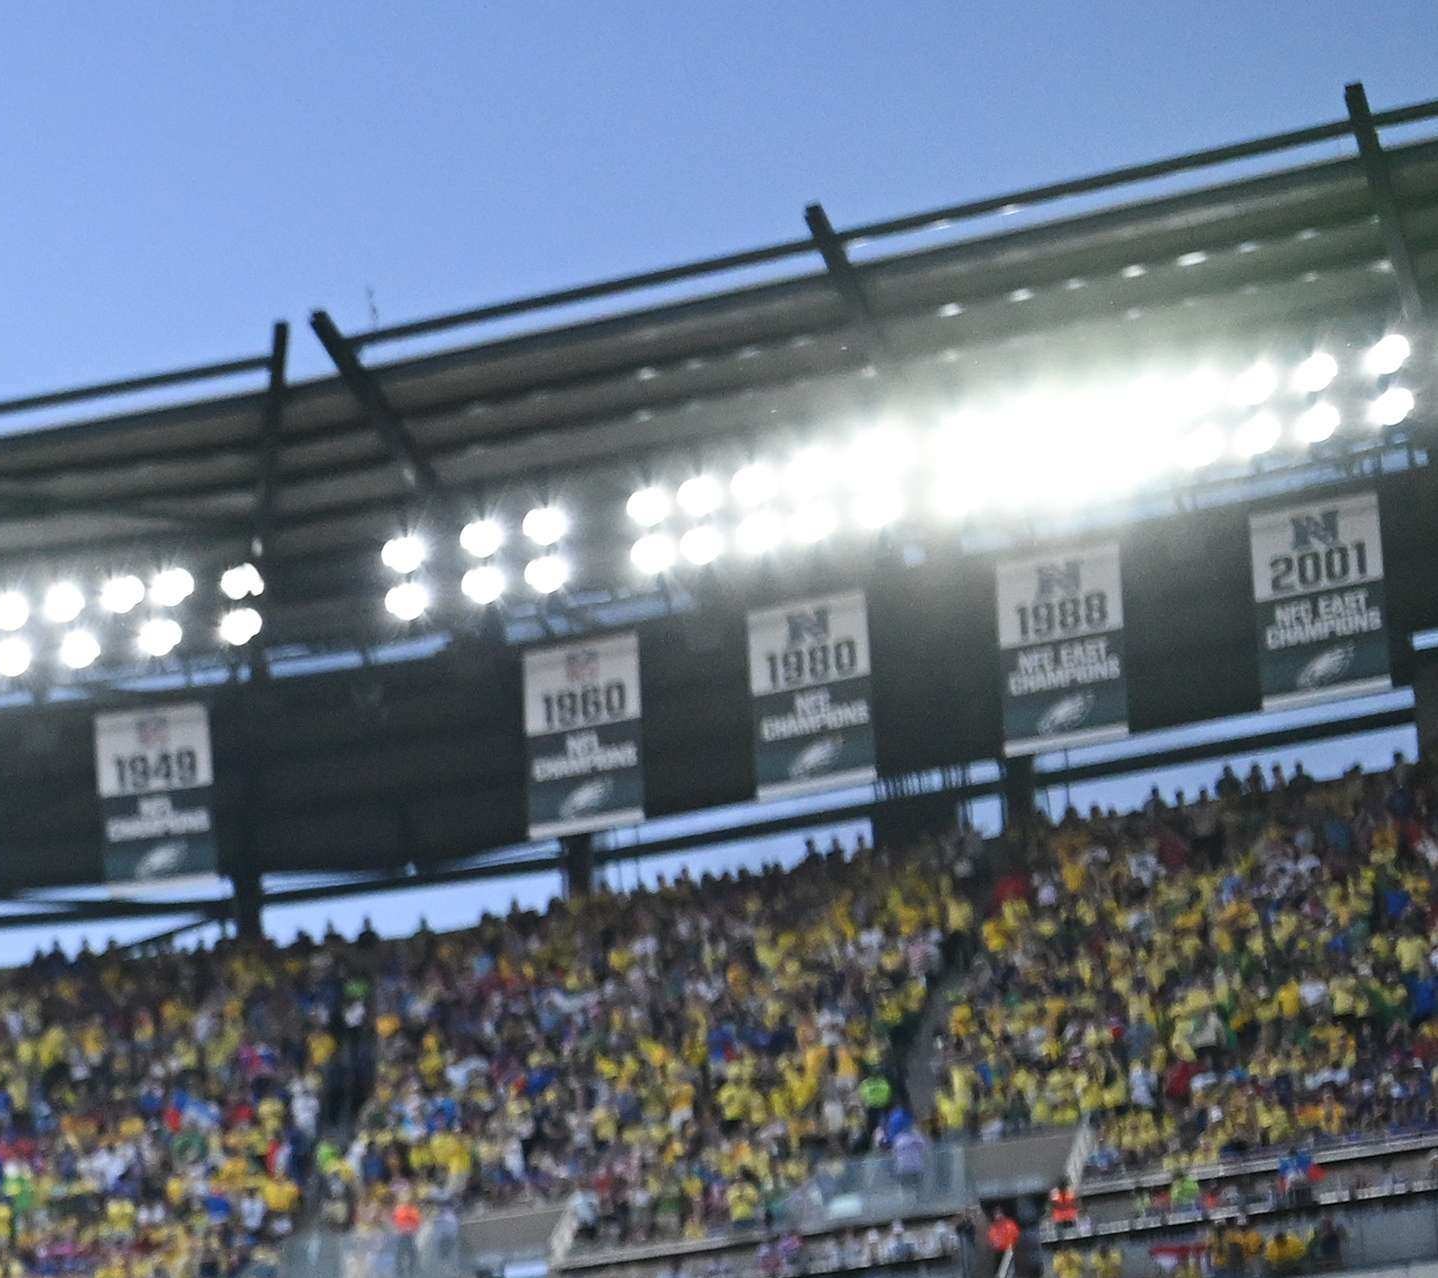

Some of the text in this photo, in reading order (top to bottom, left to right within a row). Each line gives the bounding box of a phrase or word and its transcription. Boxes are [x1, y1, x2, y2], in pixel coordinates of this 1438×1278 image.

[1269, 541, 1368, 594] 2001
[1015, 591, 1108, 642] 1988
[1266, 606, 1382, 651] CHAMPIONS
[766, 640, 857, 689] 1980
[1008, 654, 1121, 696] CHAMPIONS
[542, 679, 627, 730] 1960
[760, 699, 871, 743] CHAMPIONS
[115, 746, 198, 792] 1949
